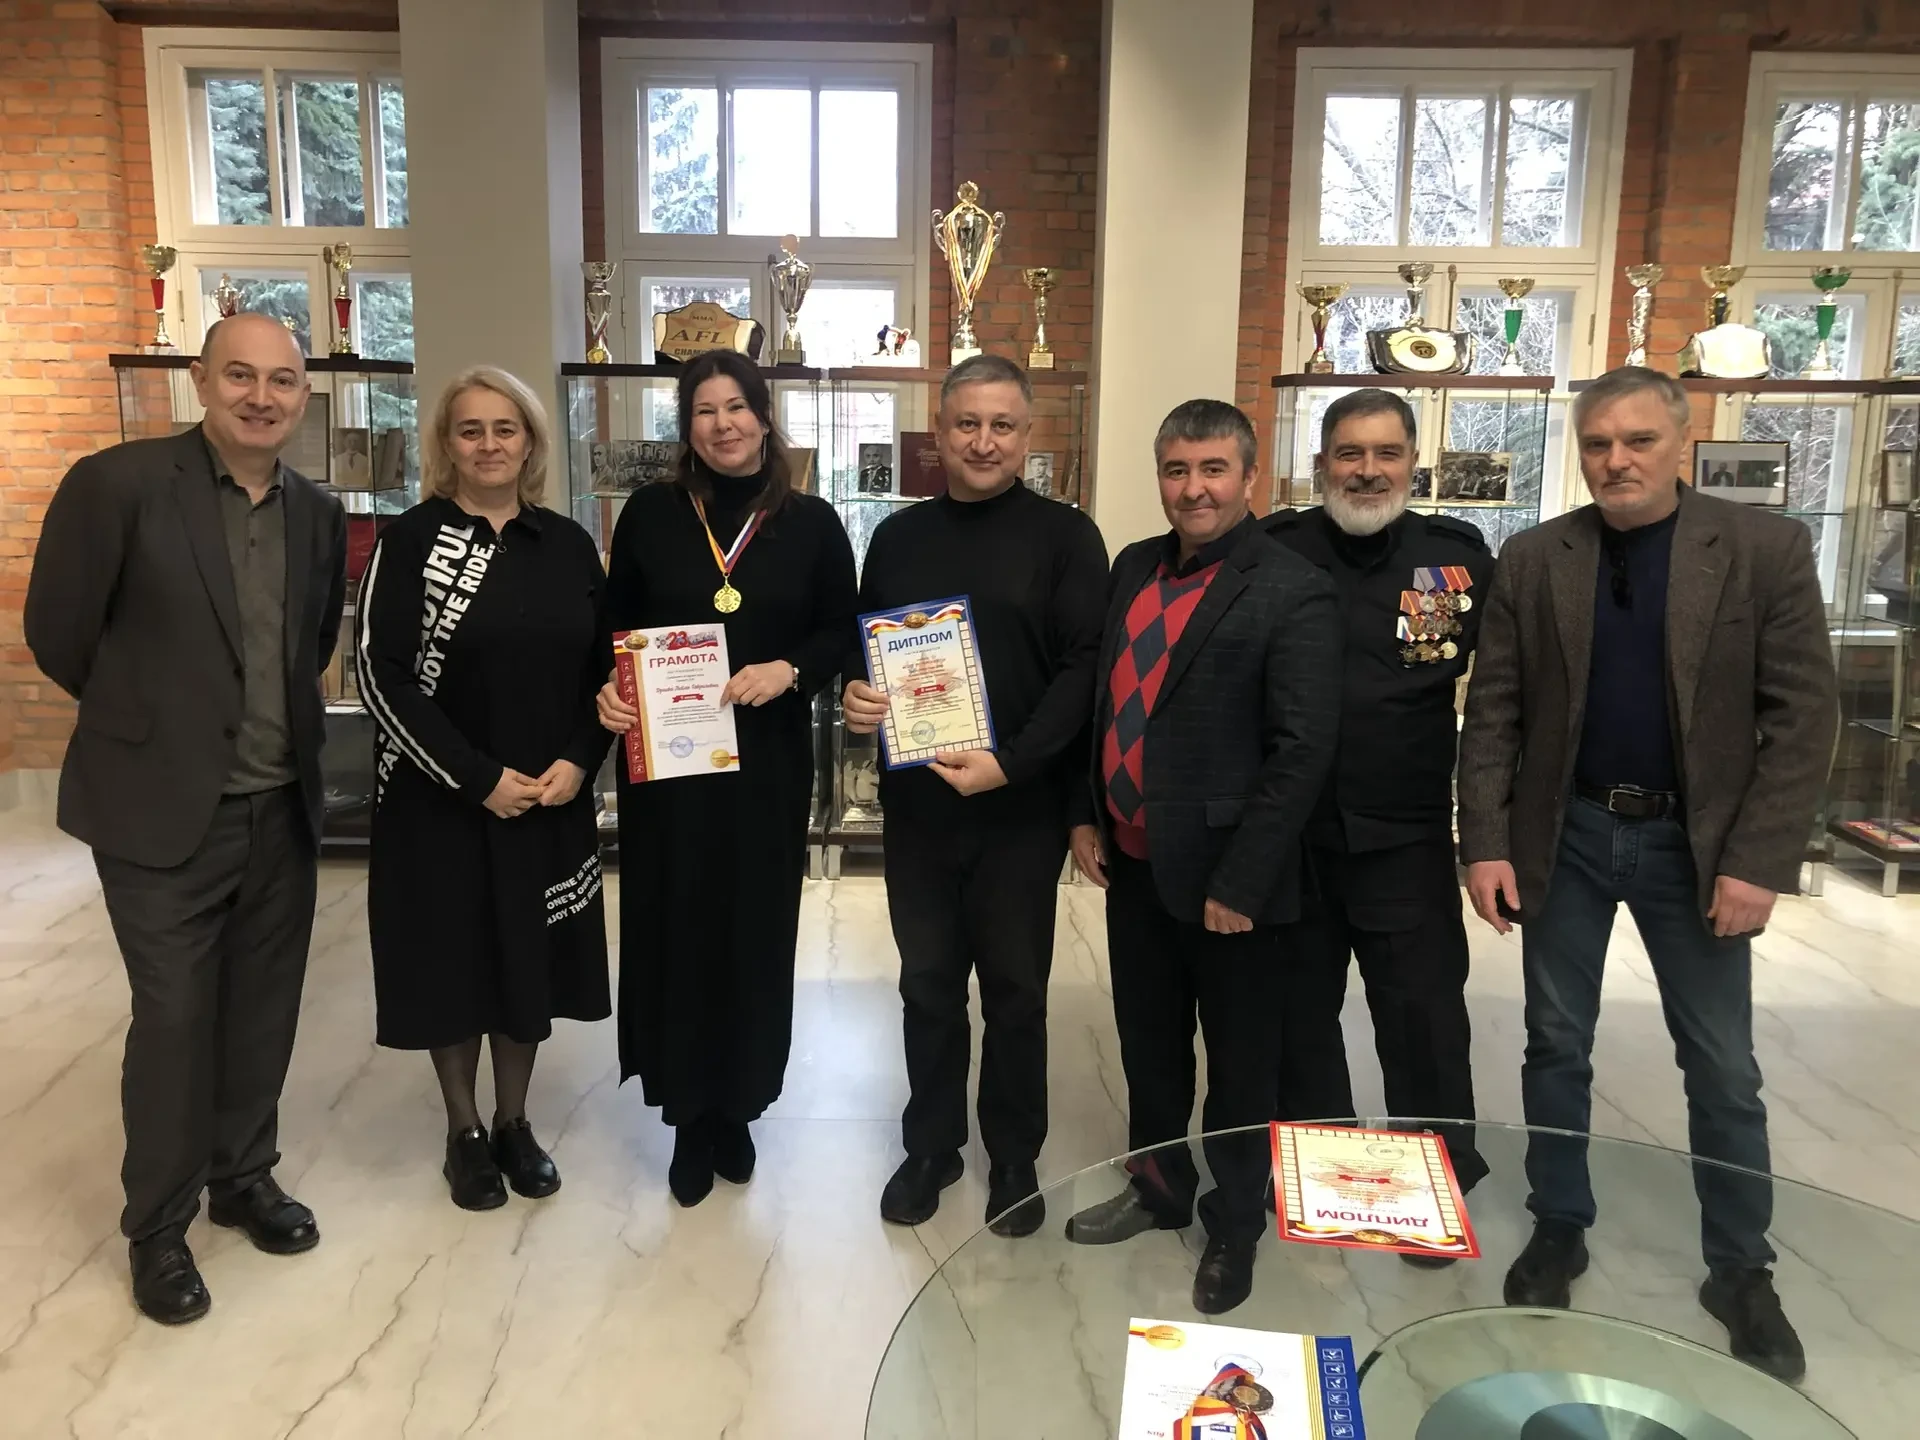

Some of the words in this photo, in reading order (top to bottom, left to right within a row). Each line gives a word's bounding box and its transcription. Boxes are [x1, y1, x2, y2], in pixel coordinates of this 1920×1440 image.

[669, 329, 726, 344] AFL
[433, 592, 471, 642] THE
[888, 630, 953, 652] ДИПЛОМ
[649, 653, 718, 668] ГРАМОТА
[582, 854, 598, 871] THE
[569, 897, 589, 914] THE
[1316, 1209, 1428, 1227] ДИПЛОМ
